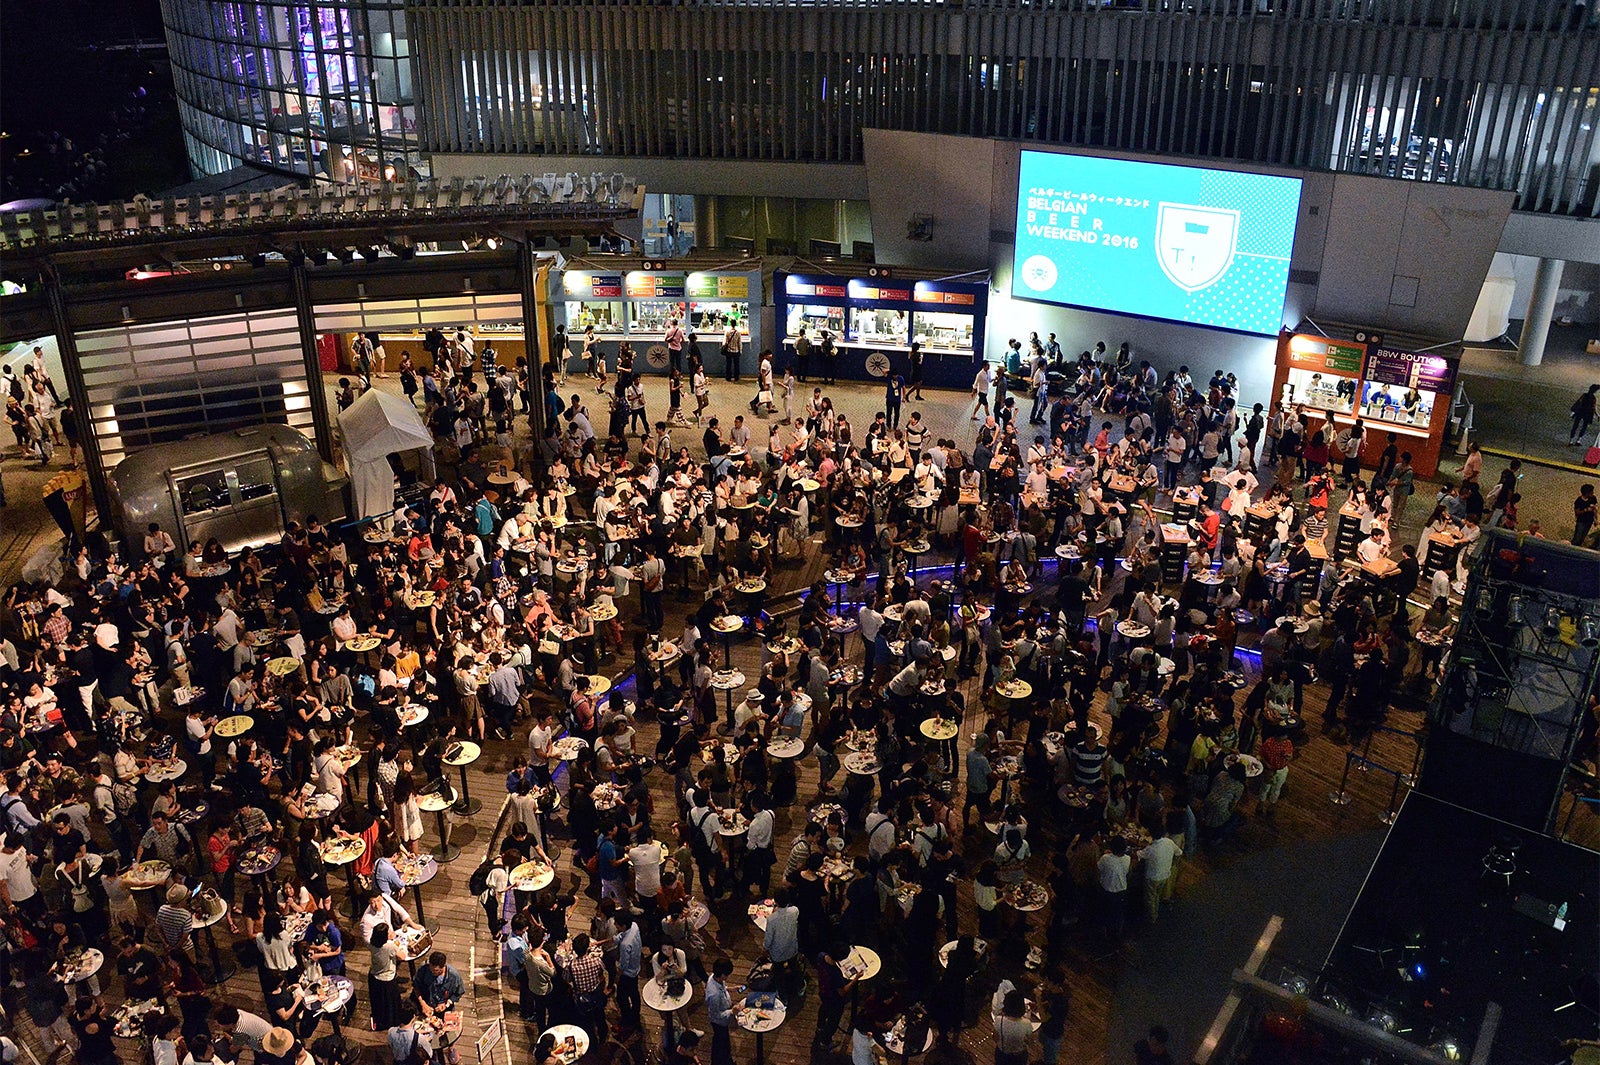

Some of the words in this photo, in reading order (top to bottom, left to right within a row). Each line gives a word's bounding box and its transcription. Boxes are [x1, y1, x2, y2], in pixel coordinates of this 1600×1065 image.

[1028, 197, 1087, 215] BELGIAN
[1029, 188, 1150, 208] ベルギービールウィークエンド
[1027, 224, 1097, 243] WEEKEND
[1102, 234, 1138, 249] 2016
[1377, 350, 1398, 358] BBW
